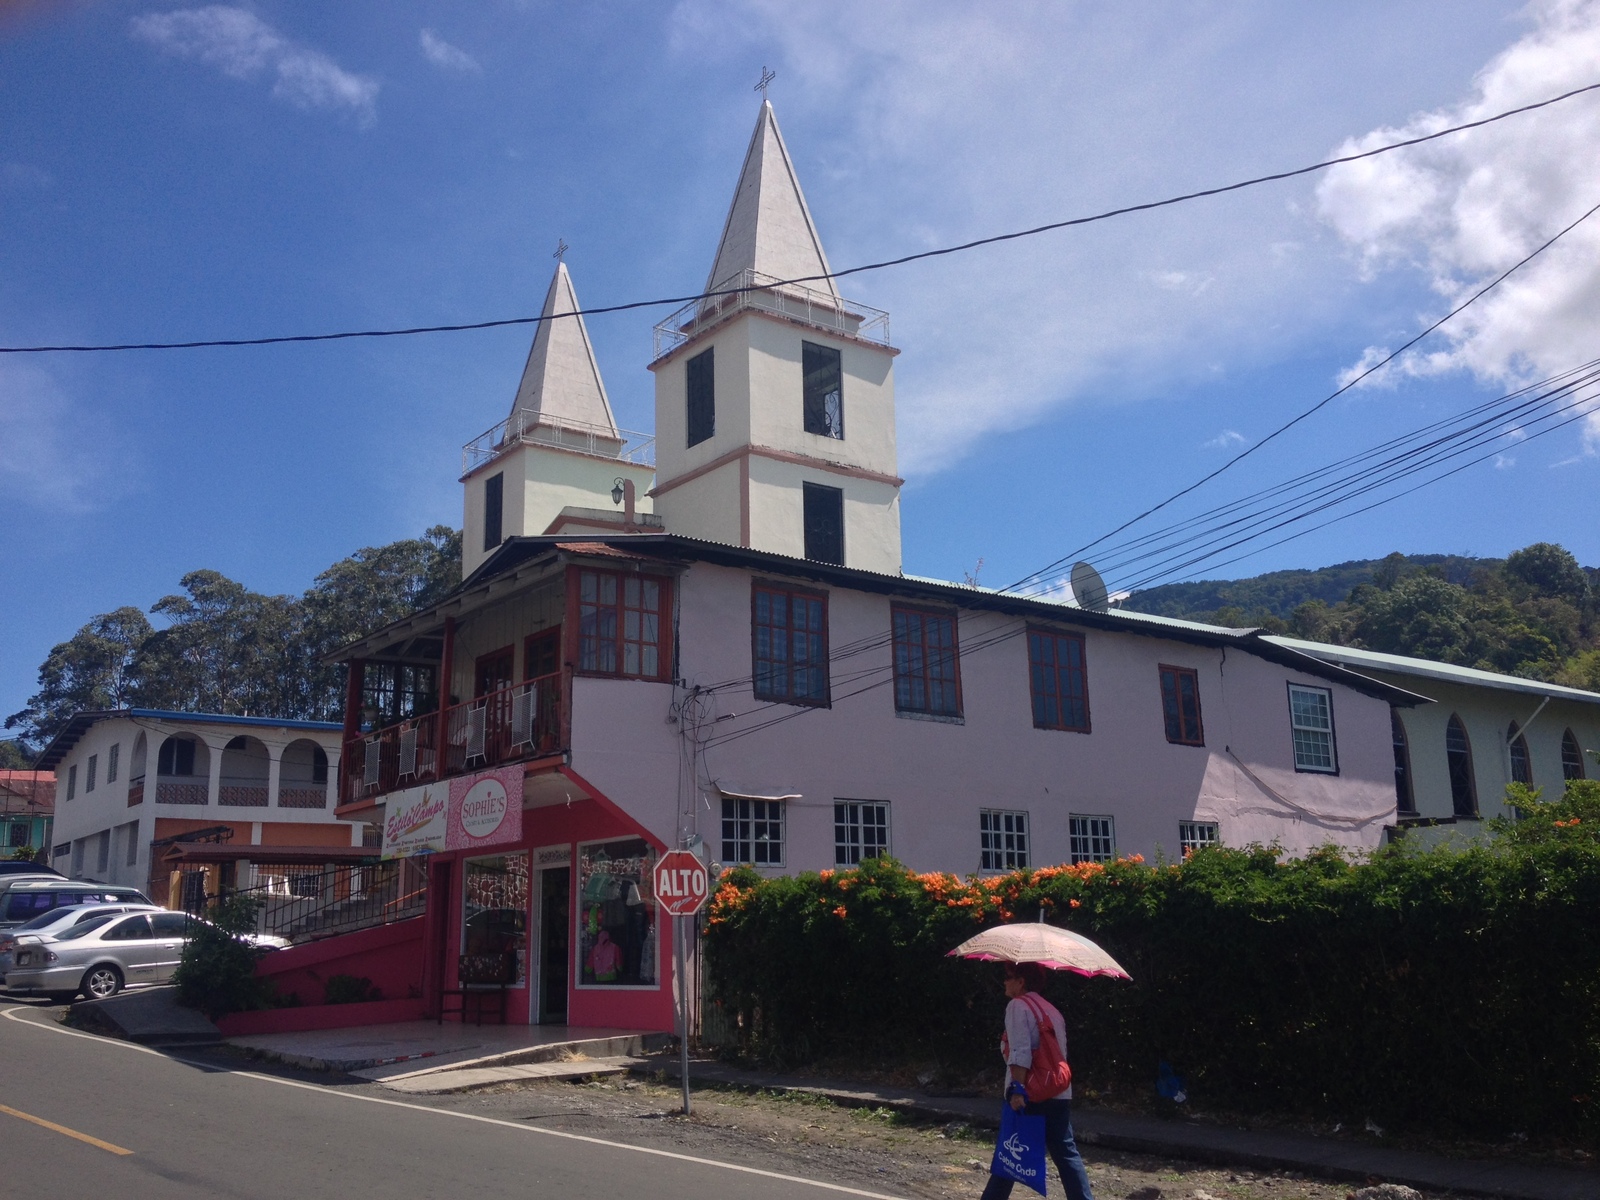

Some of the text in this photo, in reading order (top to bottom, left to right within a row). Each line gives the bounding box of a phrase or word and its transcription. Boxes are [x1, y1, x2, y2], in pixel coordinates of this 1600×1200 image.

[463, 796, 505, 819] SOPHIE'S
[659, 869, 705, 897] ALTO
[998, 1151, 1015, 1170] Cable
[1015, 1164, 1037, 1177] Onda
